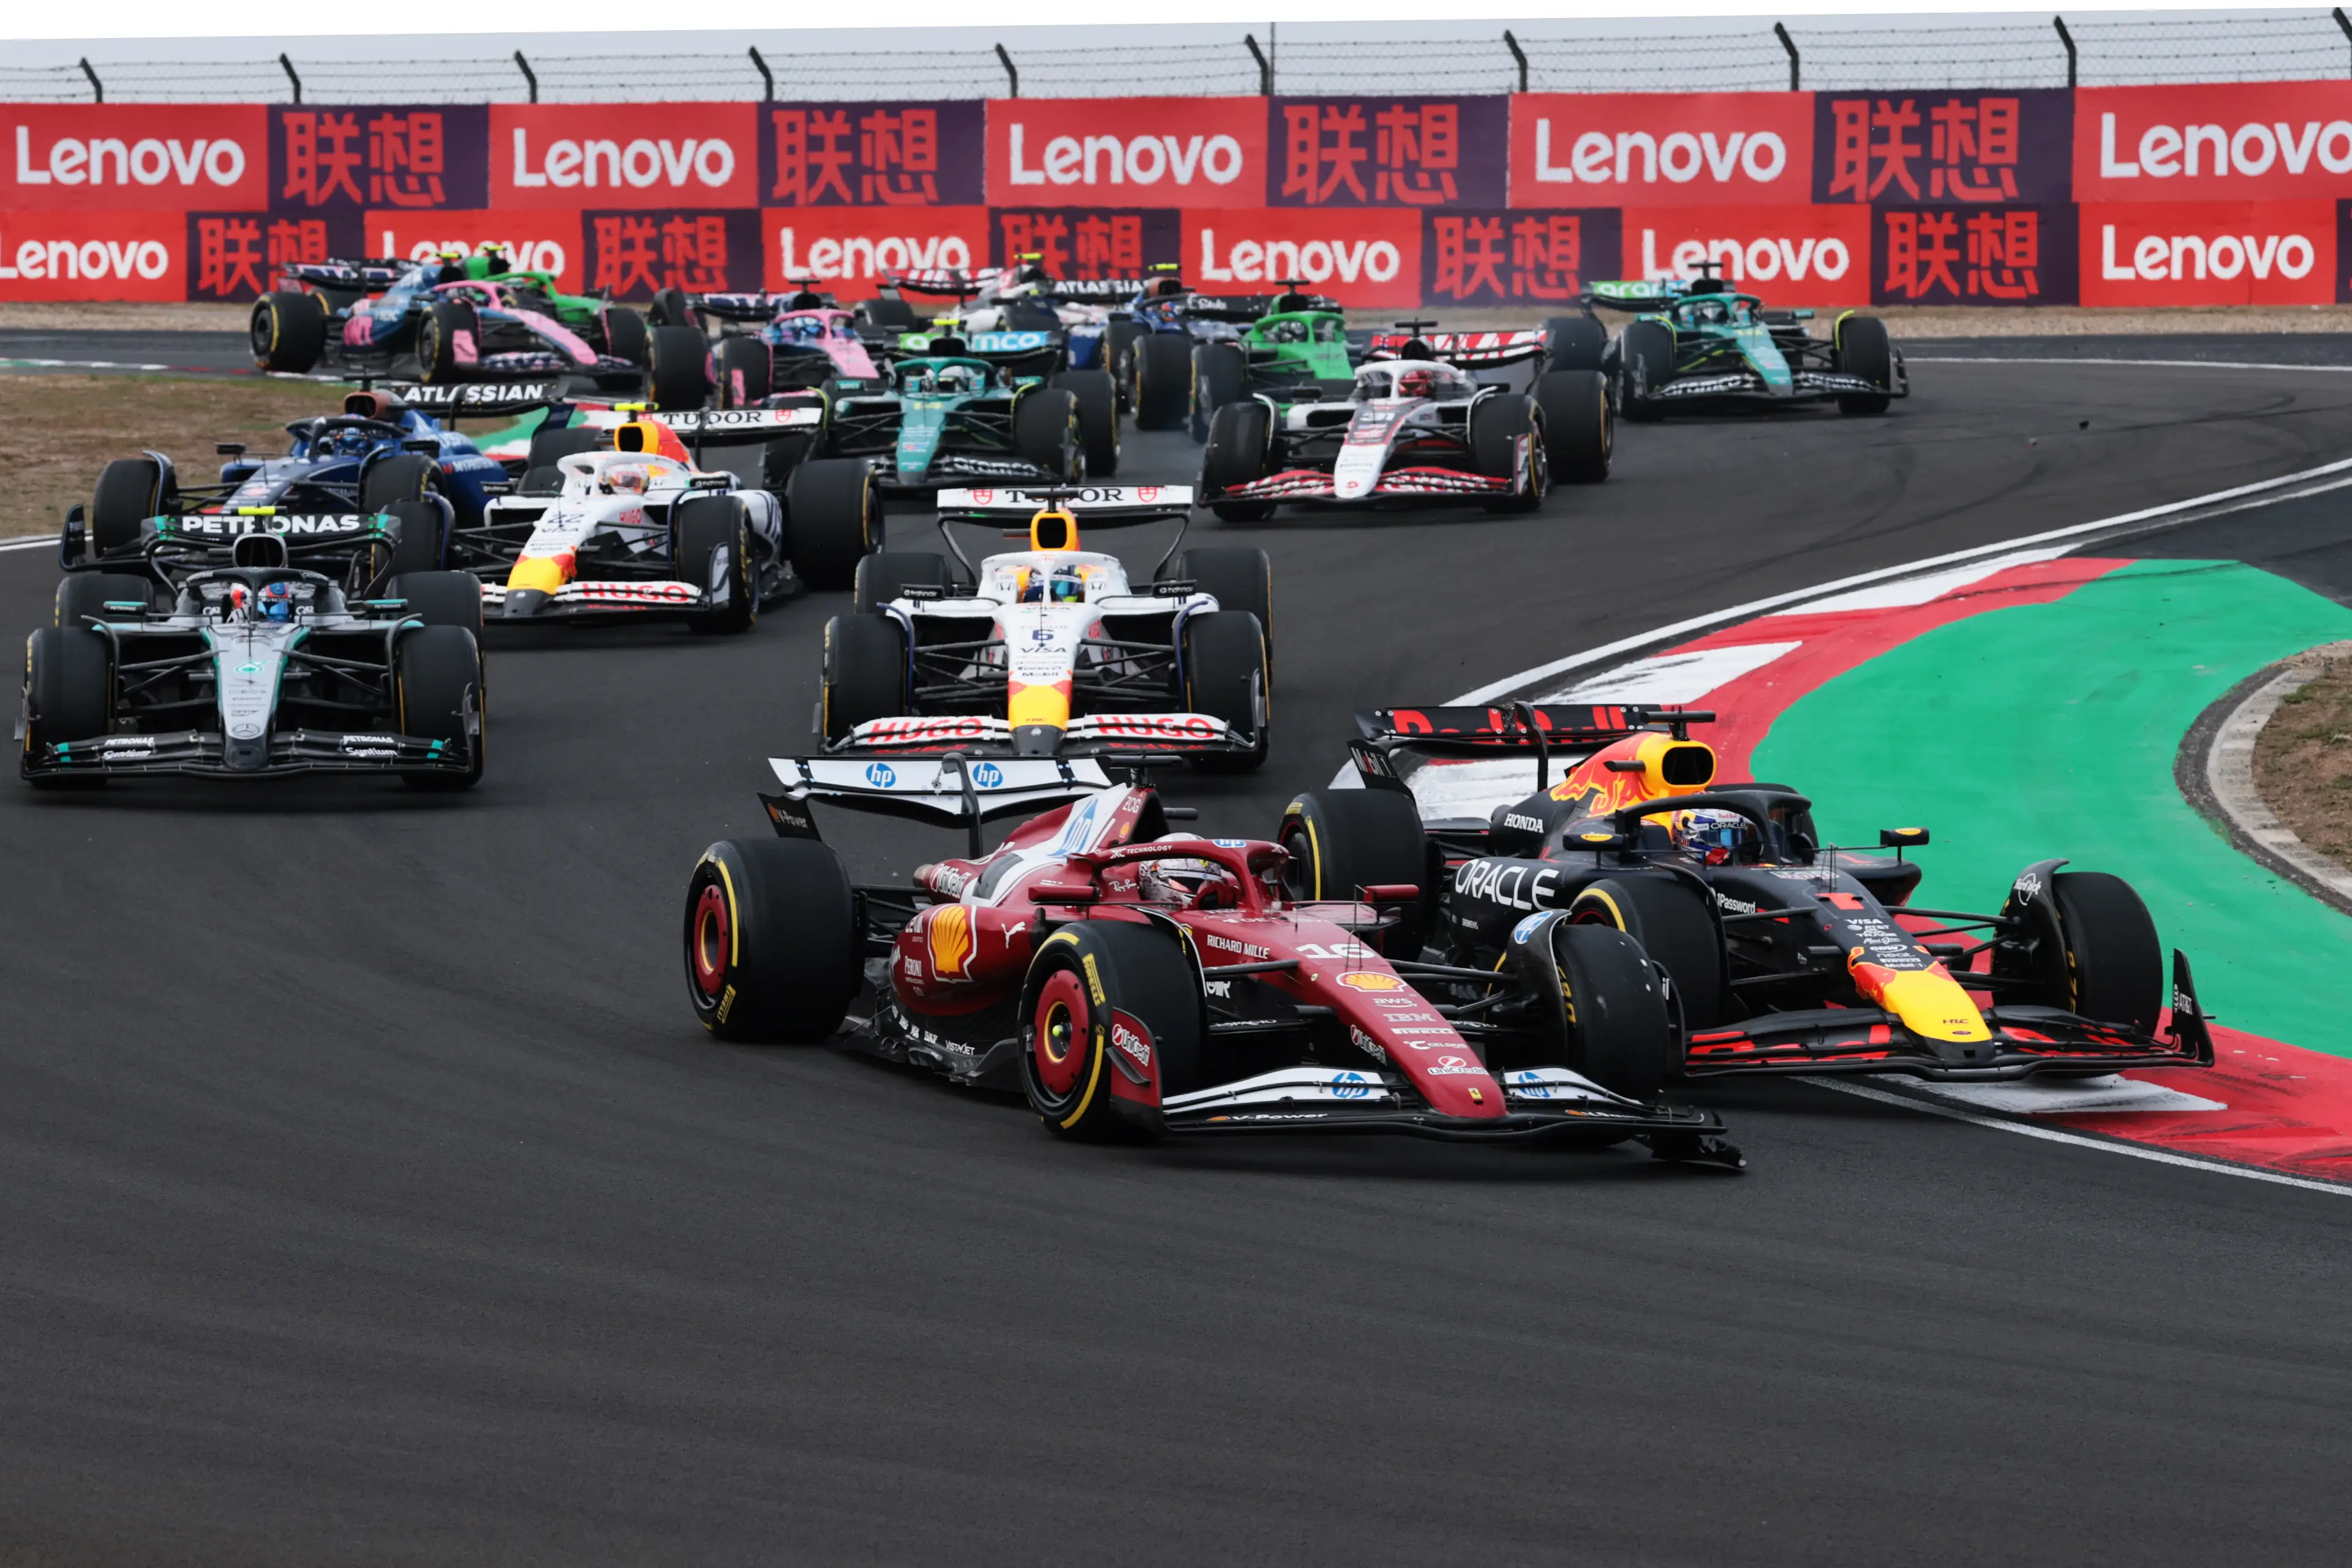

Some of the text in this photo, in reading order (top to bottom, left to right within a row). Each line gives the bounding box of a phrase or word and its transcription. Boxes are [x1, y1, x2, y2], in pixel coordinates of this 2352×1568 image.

[17, 126, 244, 186] Lenovo
[513, 128, 734, 188] Lenovo
[772, 109, 940, 206] 联想
[1010, 123, 1243, 186] Lenovo
[1281, 104, 1459, 205] 联想
[1536, 118, 1787, 183] Lenovo
[1828, 97, 2019, 202] 联想
[2100, 112, 2352, 178] Lenovo
[282, 111, 446, 206] 联想
[594, 215, 728, 297] 联想
[780, 227, 970, 280] Lenovo
[1201, 228, 1400, 283] Lenovo
[1433, 215, 1581, 300] 联想
[1642, 228, 1850, 281] Lenovo
[1884, 211, 2040, 299] 联想
[2101, 224, 2315, 280] Lenovo
[663, 411, 762, 425] TUDOR
[1005, 488, 1123, 502] TOR
[581, 583, 688, 602] HUGO
[1032, 629, 1054, 641] 6
[343, 735, 394, 744] PETRONAS
[868, 718, 984, 744] HUGO
[1095, 716, 1215, 739] HUGO
[105, 737, 155, 746] PETRONAS
[345, 747, 398, 757] Syntium
[869, 763, 893, 788] hp
[978, 763, 1001, 788] hp
[1122, 796, 1142, 813] ZCG
[777, 809, 808, 829] V-Power
[1504, 813, 1544, 833] HONDA
[1127, 845, 1172, 854] TECHNOLOGY
[1455, 858, 1559, 911] ORACLE
[1717, 892, 1756, 914] 1Password
[1207, 934, 1270, 960] RICHARD MILLE
[1295, 944, 1376, 959] 16
[905, 956, 922, 977] PERONI
[1382, 1013, 1436, 1022] IBM
[924, 1031, 938, 1044] SKF
[1121, 1029, 1150, 1066] UniCredit
